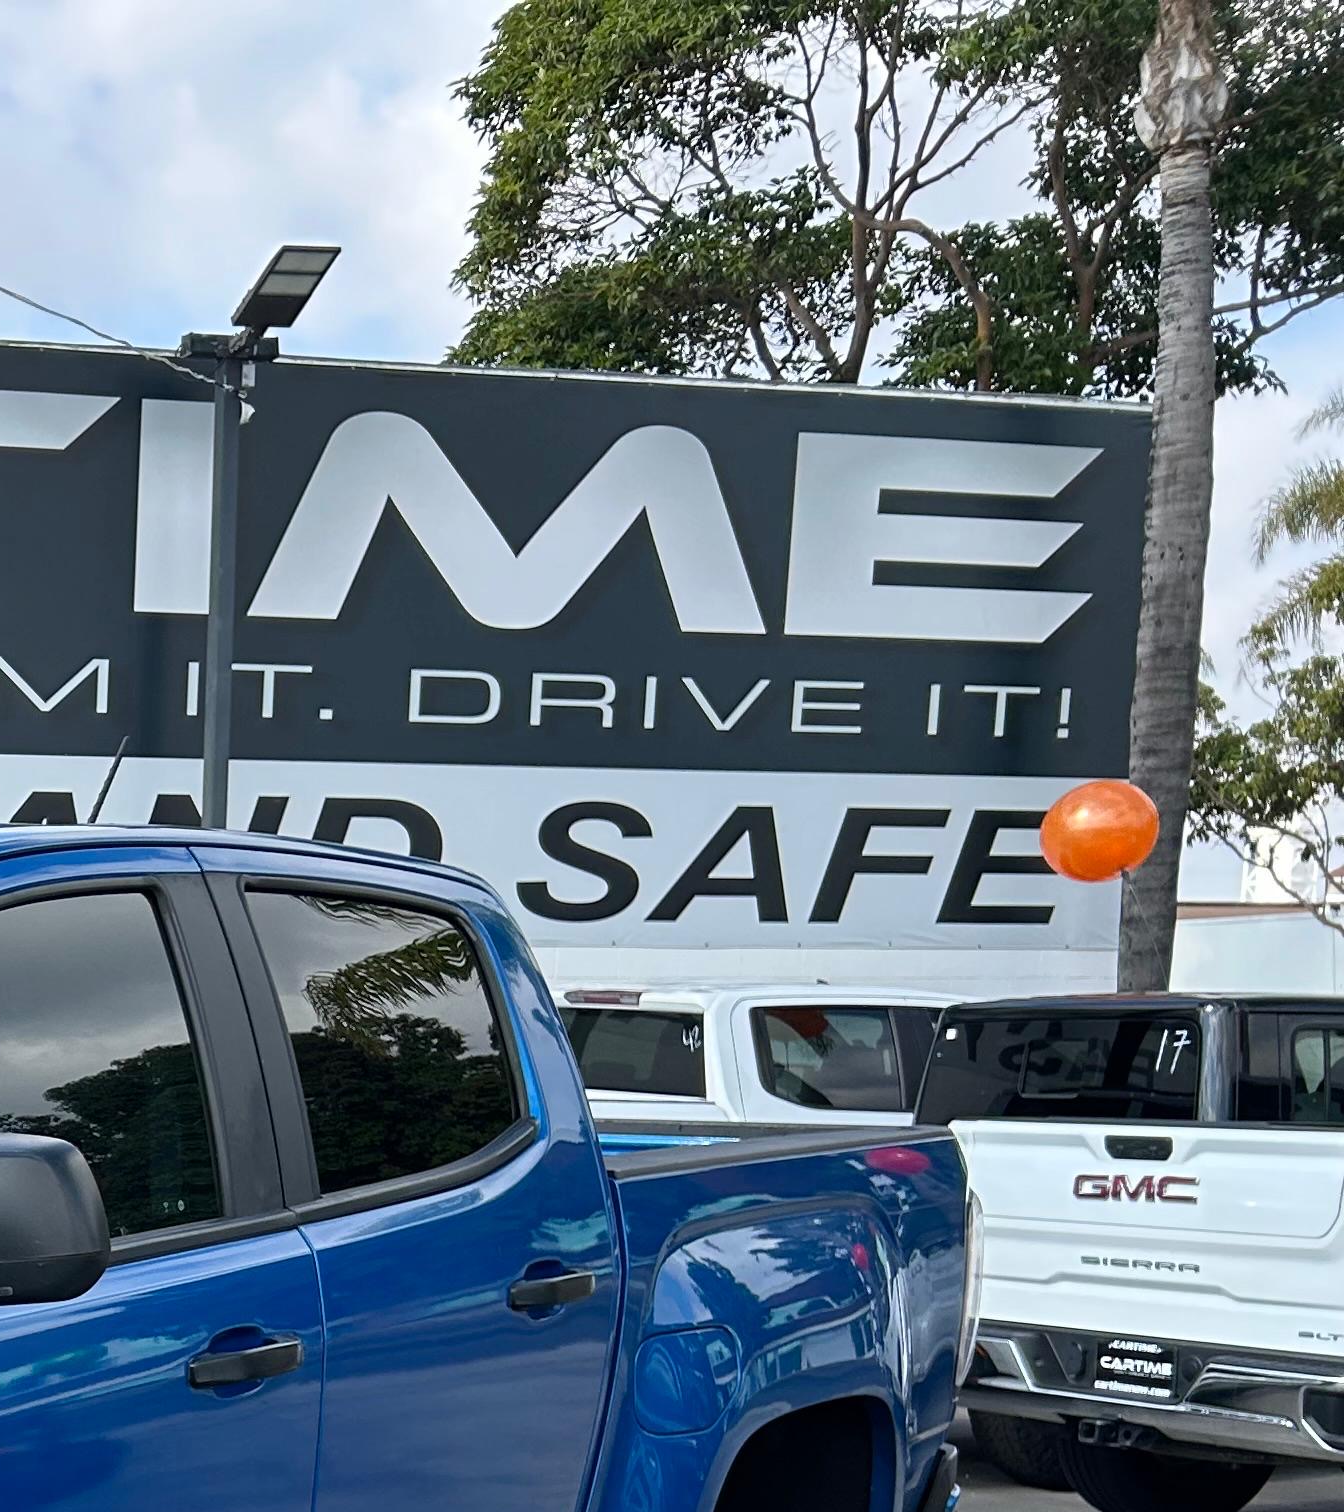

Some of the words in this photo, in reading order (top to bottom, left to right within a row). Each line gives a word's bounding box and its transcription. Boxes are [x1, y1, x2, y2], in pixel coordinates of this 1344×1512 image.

[187, 660, 335, 721] IT.
[408, 667, 866, 735] DRIVE
[926, 683, 1073, 739] IT!
[515, 800, 1058, 925] SAFE
[1154, 1029, 1193, 1074] 17
[1072, 1173, 1201, 1205] GMC
[1080, 1255, 1201, 1274] SIERRA
[1099, 1355, 1173, 1376] CARTIME
